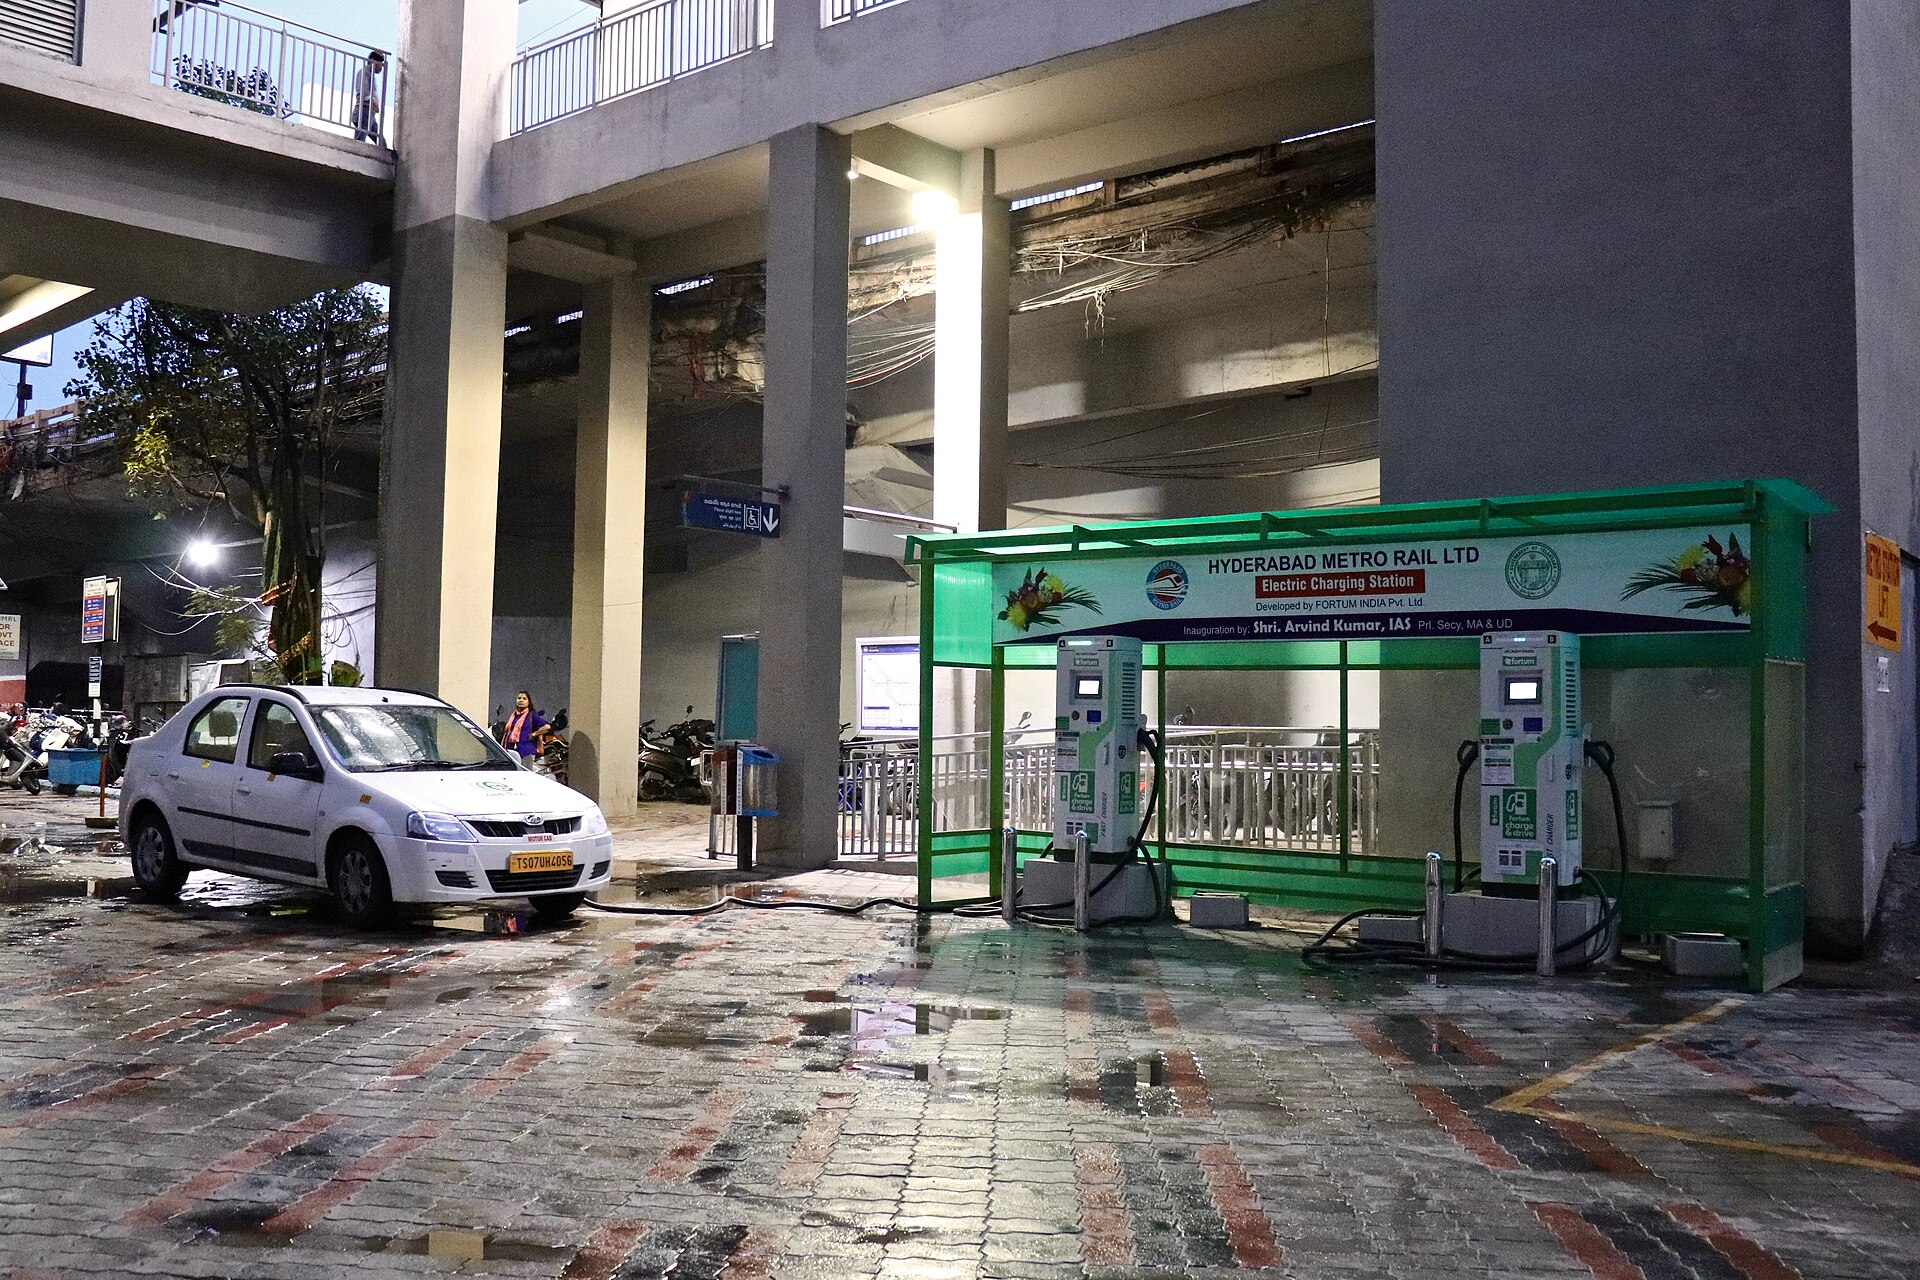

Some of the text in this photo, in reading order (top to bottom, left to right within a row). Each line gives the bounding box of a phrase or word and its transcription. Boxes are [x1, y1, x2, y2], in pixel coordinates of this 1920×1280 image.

[1209, 547, 1480, 574] HYDERABAD METRO RAIL LTD
[1262, 574, 1414, 592] Electric Charging Station
[1256, 597, 1425, 612] Developed by FORTUM INDIA Pvt. Ltd.
[1183, 617, 1513, 637] Inauguration by: Shri. Arvind Kumar, IAS Prl. Secy, MA & UD
[1505, 821, 1534, 830] charge
[1505, 829, 1534, 837] & drive
[1546, 813, 1554, 845] CHARGER
[517, 855, 572, 869] TS07UH4056
